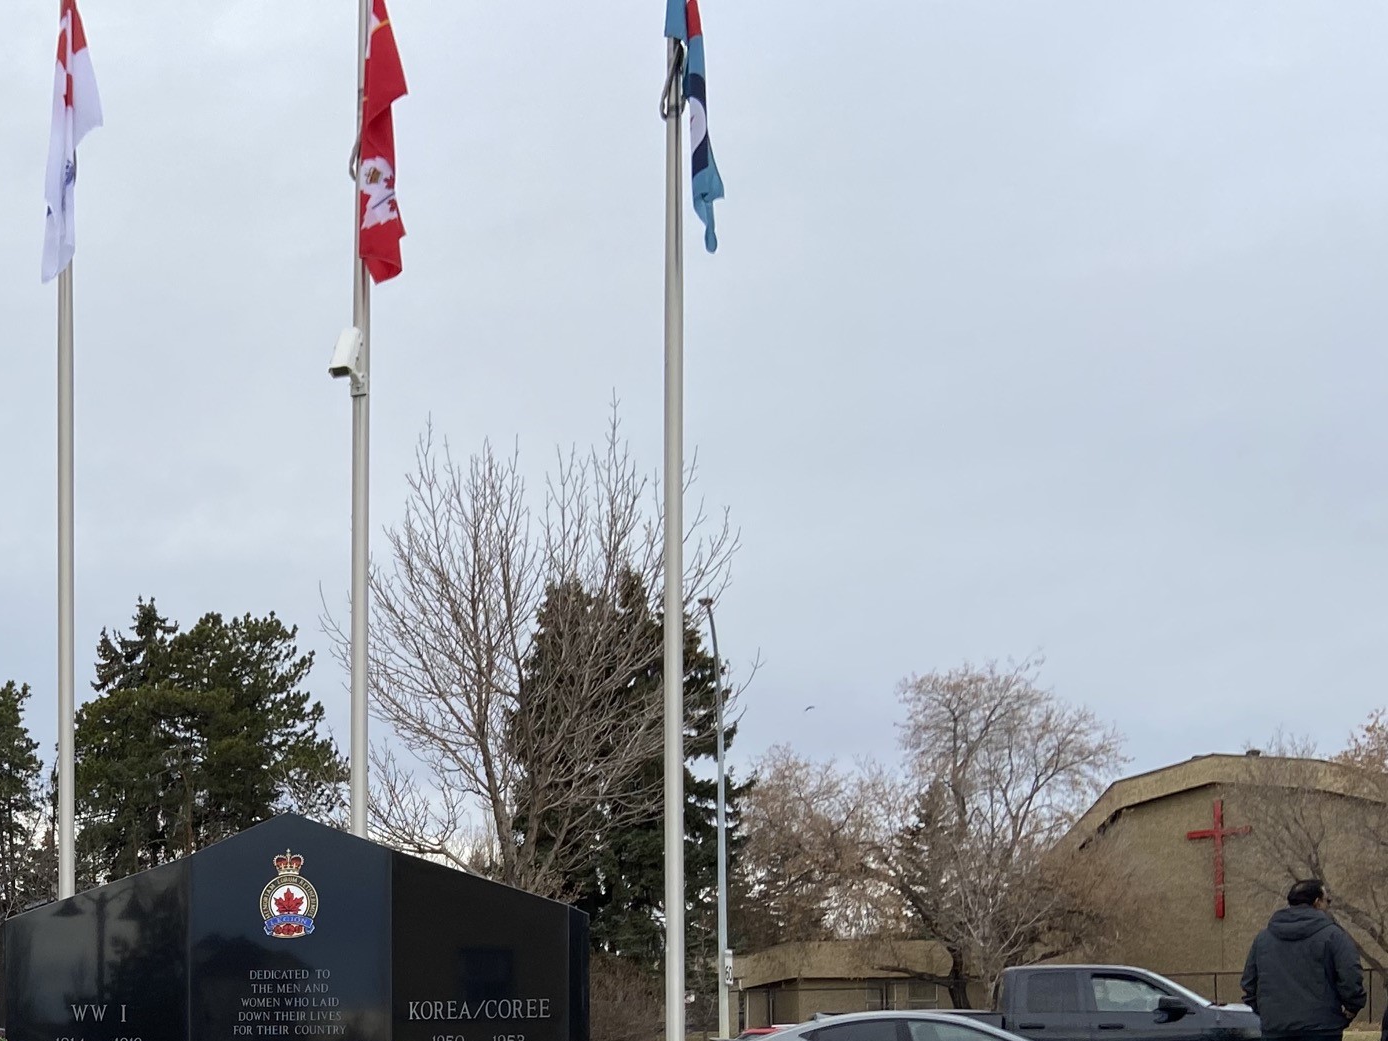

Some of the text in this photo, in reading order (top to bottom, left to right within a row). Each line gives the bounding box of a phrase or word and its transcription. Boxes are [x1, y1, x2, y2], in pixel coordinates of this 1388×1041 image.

[249, 969, 331, 980] DEDICATED TO
[251, 983, 329, 994] THE MEN AND
[241, 997, 340, 1008] WOMEN WHO LAID
[71, 1004, 127, 1023] WW I
[409, 999, 551, 1020] KOREA/COREE
[238, 1011, 342, 1022] DOWN THEIR LIVES
[233, 1025, 347, 1036] FOR THEIR COUNTRY
